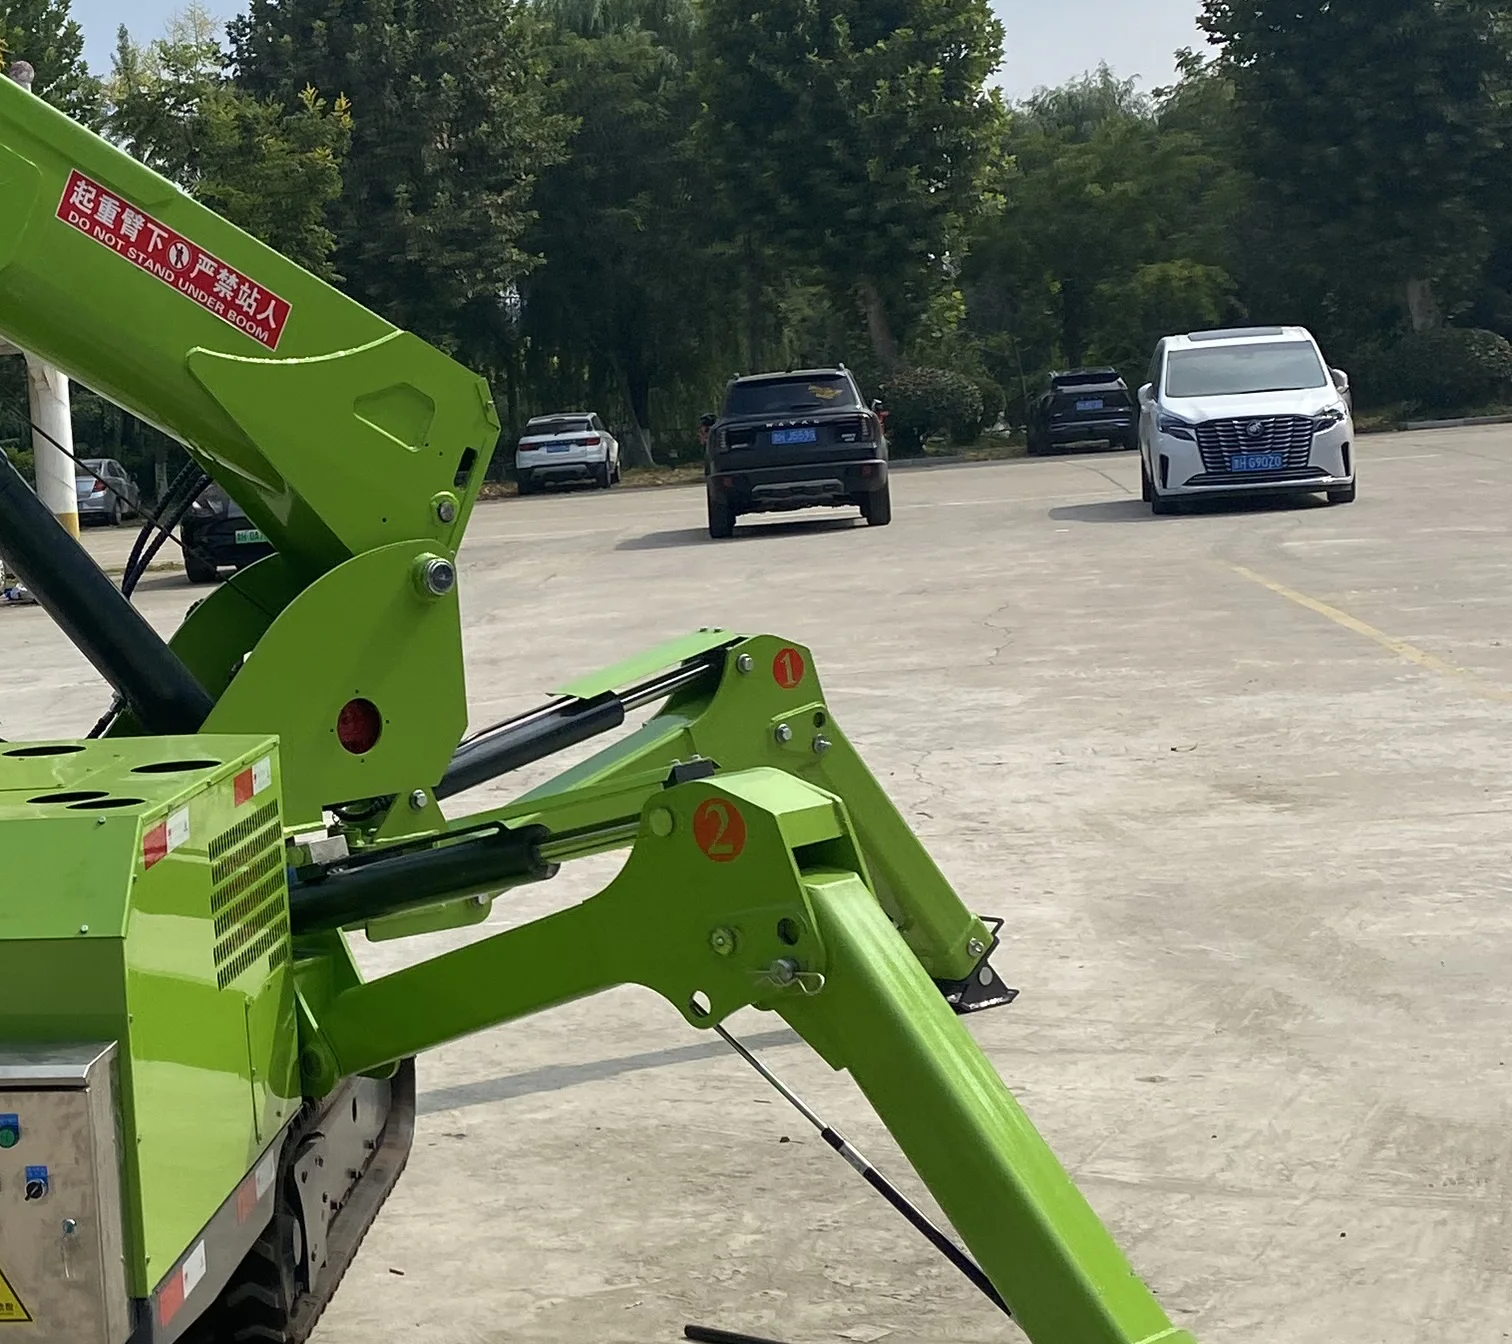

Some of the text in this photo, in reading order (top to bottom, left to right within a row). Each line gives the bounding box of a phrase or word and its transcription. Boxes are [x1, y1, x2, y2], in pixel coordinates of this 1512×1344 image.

[68, 210, 269, 342] DO NOT STAND UNDER BOOM
[69, 179, 276, 329] 起重臂下 严禁站人
[780, 652, 797, 686] 1
[704, 803, 734, 856] 2
